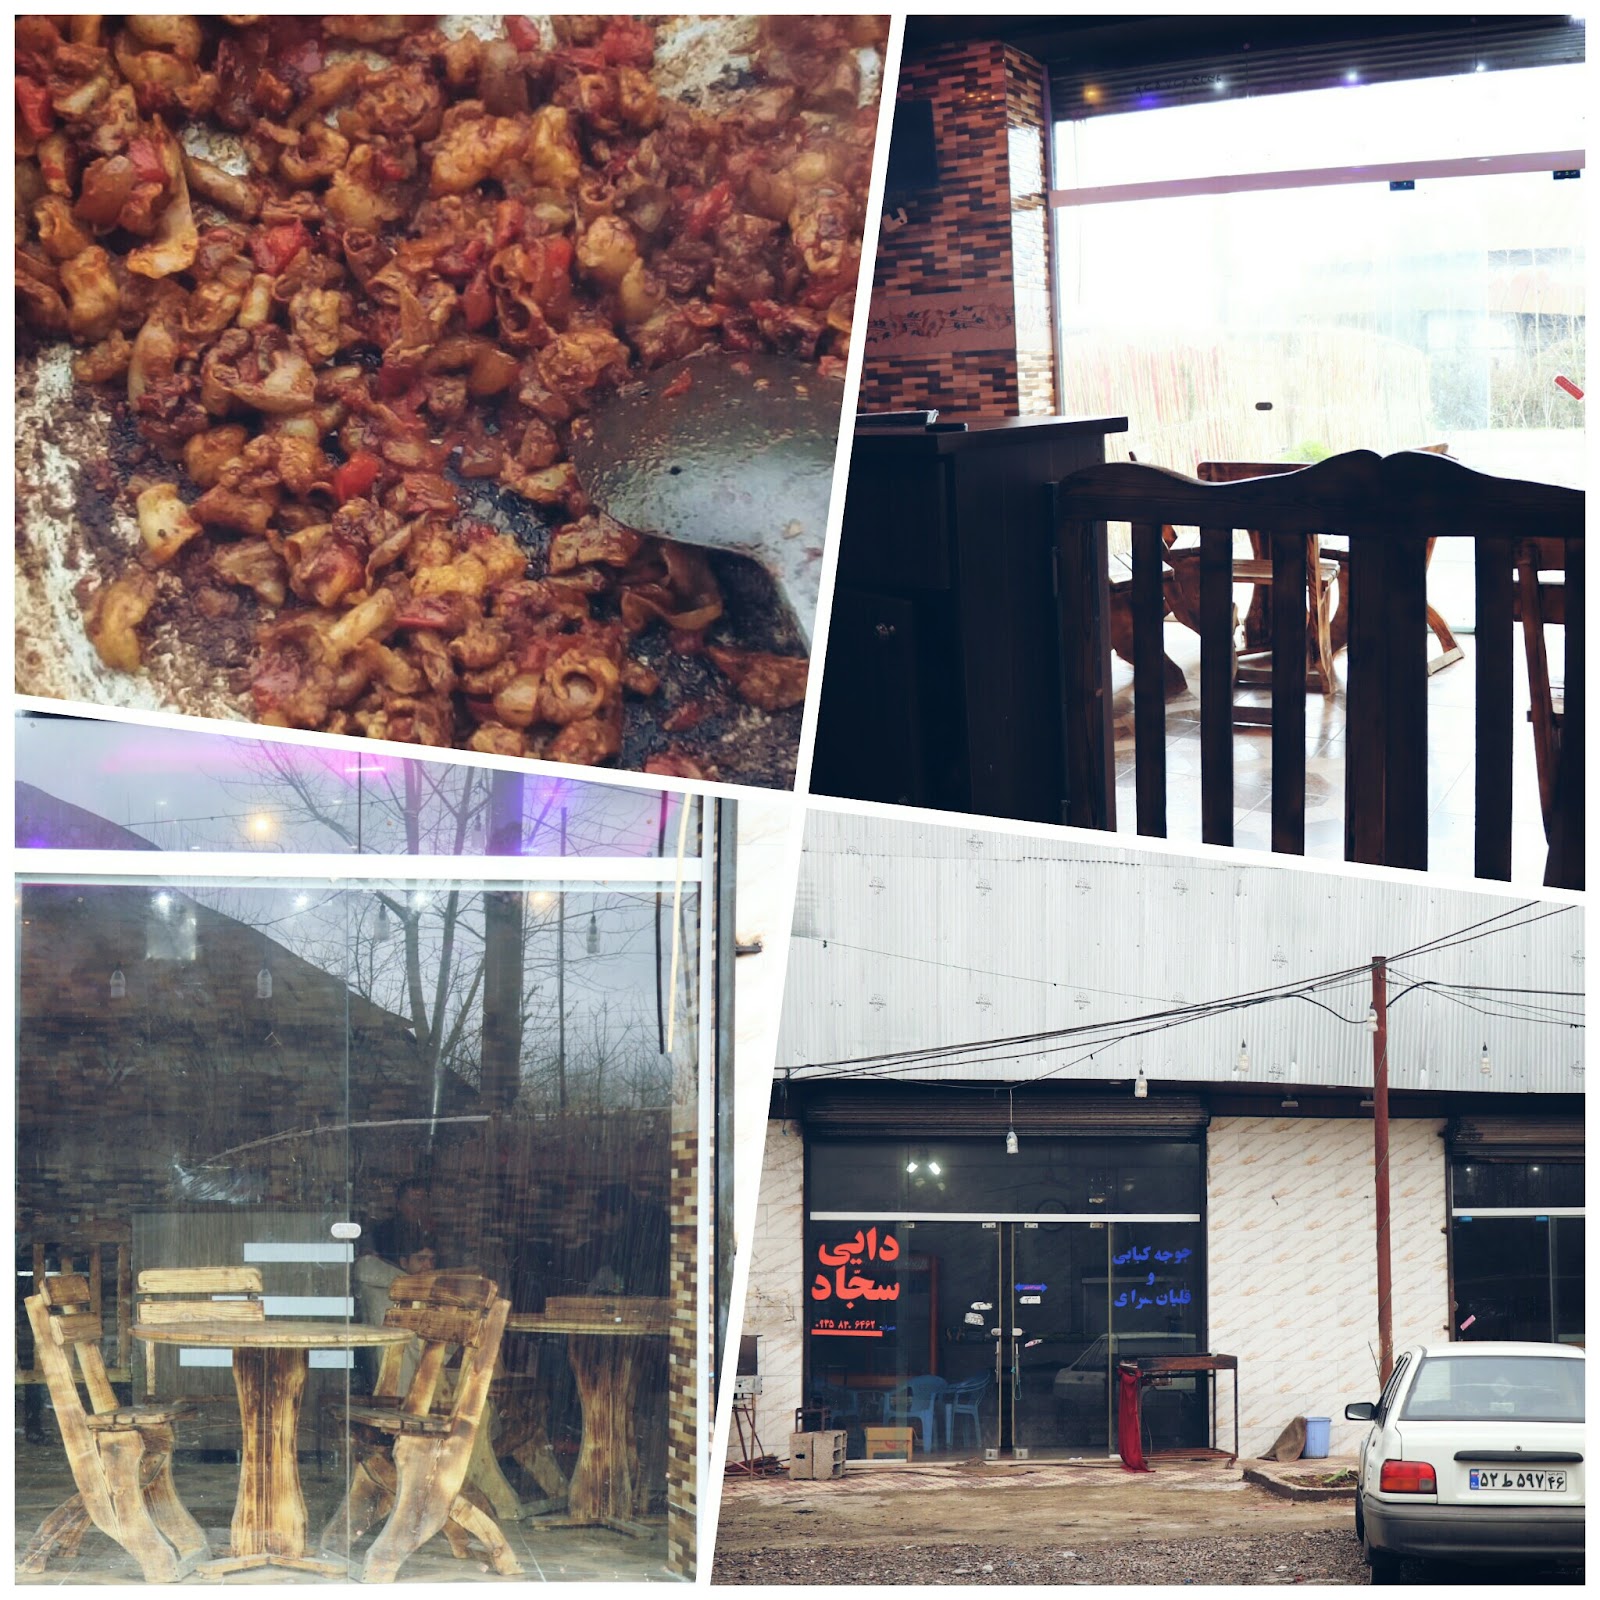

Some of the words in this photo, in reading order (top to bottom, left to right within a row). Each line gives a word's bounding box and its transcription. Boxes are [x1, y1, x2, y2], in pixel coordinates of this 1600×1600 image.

[818, 1227, 900, 1267] دایی
[1112, 1245, 1152, 1265] کبابی
[1153, 1247, 1193, 1264] جوجه
[1146, 1271, 1155, 1286] و
[1155, 1288, 1192, 1308] قلیان
[1480, 1472, 1499, 1488] ۵۲
[1501, 1472, 1514, 1488] ط
[1516, 1472, 1545, 1489] ۵۹۷
[1547, 1476, 1565, 1490] ۴۶
